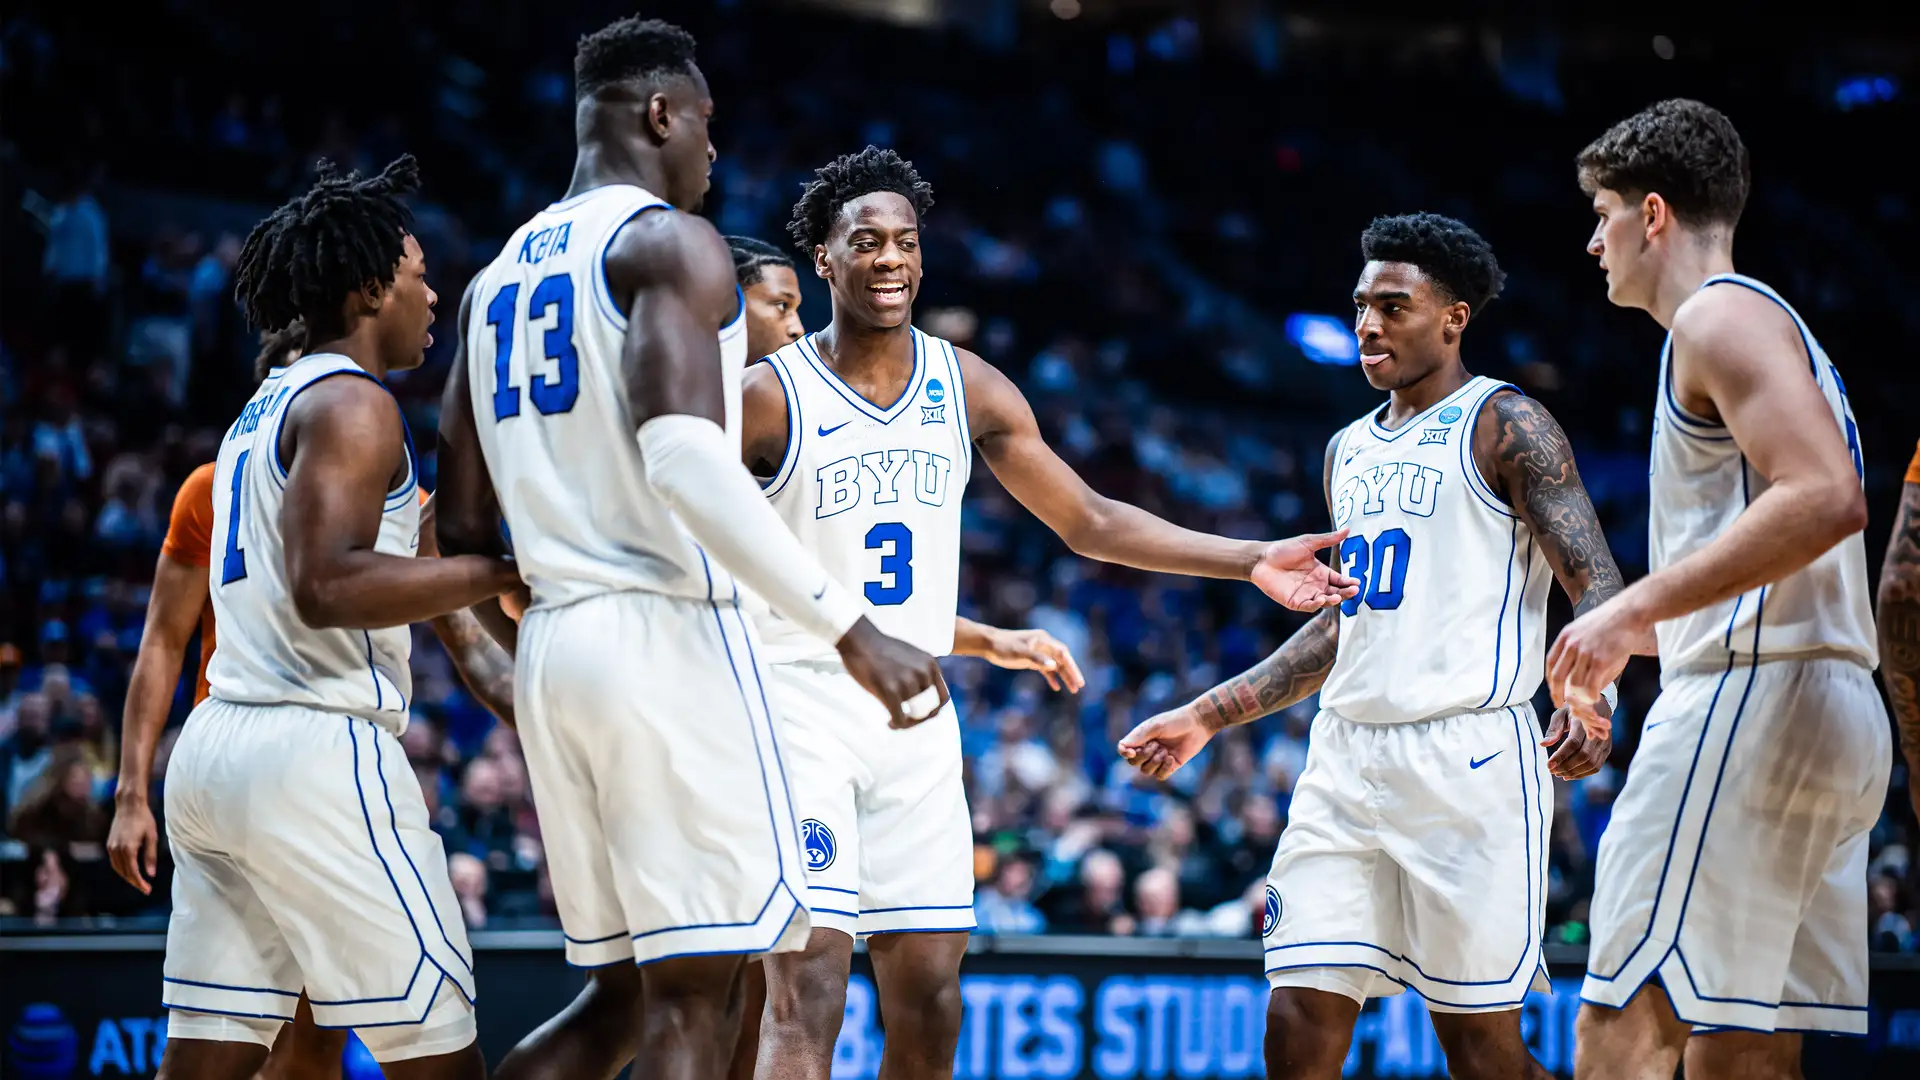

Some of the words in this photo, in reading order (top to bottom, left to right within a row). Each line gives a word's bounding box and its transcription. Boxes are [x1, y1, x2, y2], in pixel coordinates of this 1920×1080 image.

[487, 272, 579, 423] 13
[221, 449, 250, 586] 1
[816, 449, 950, 519] BYU
[1334, 462, 1443, 528] BYU
[864, 522, 912, 606] 3
[1340, 528, 1411, 617] 30
